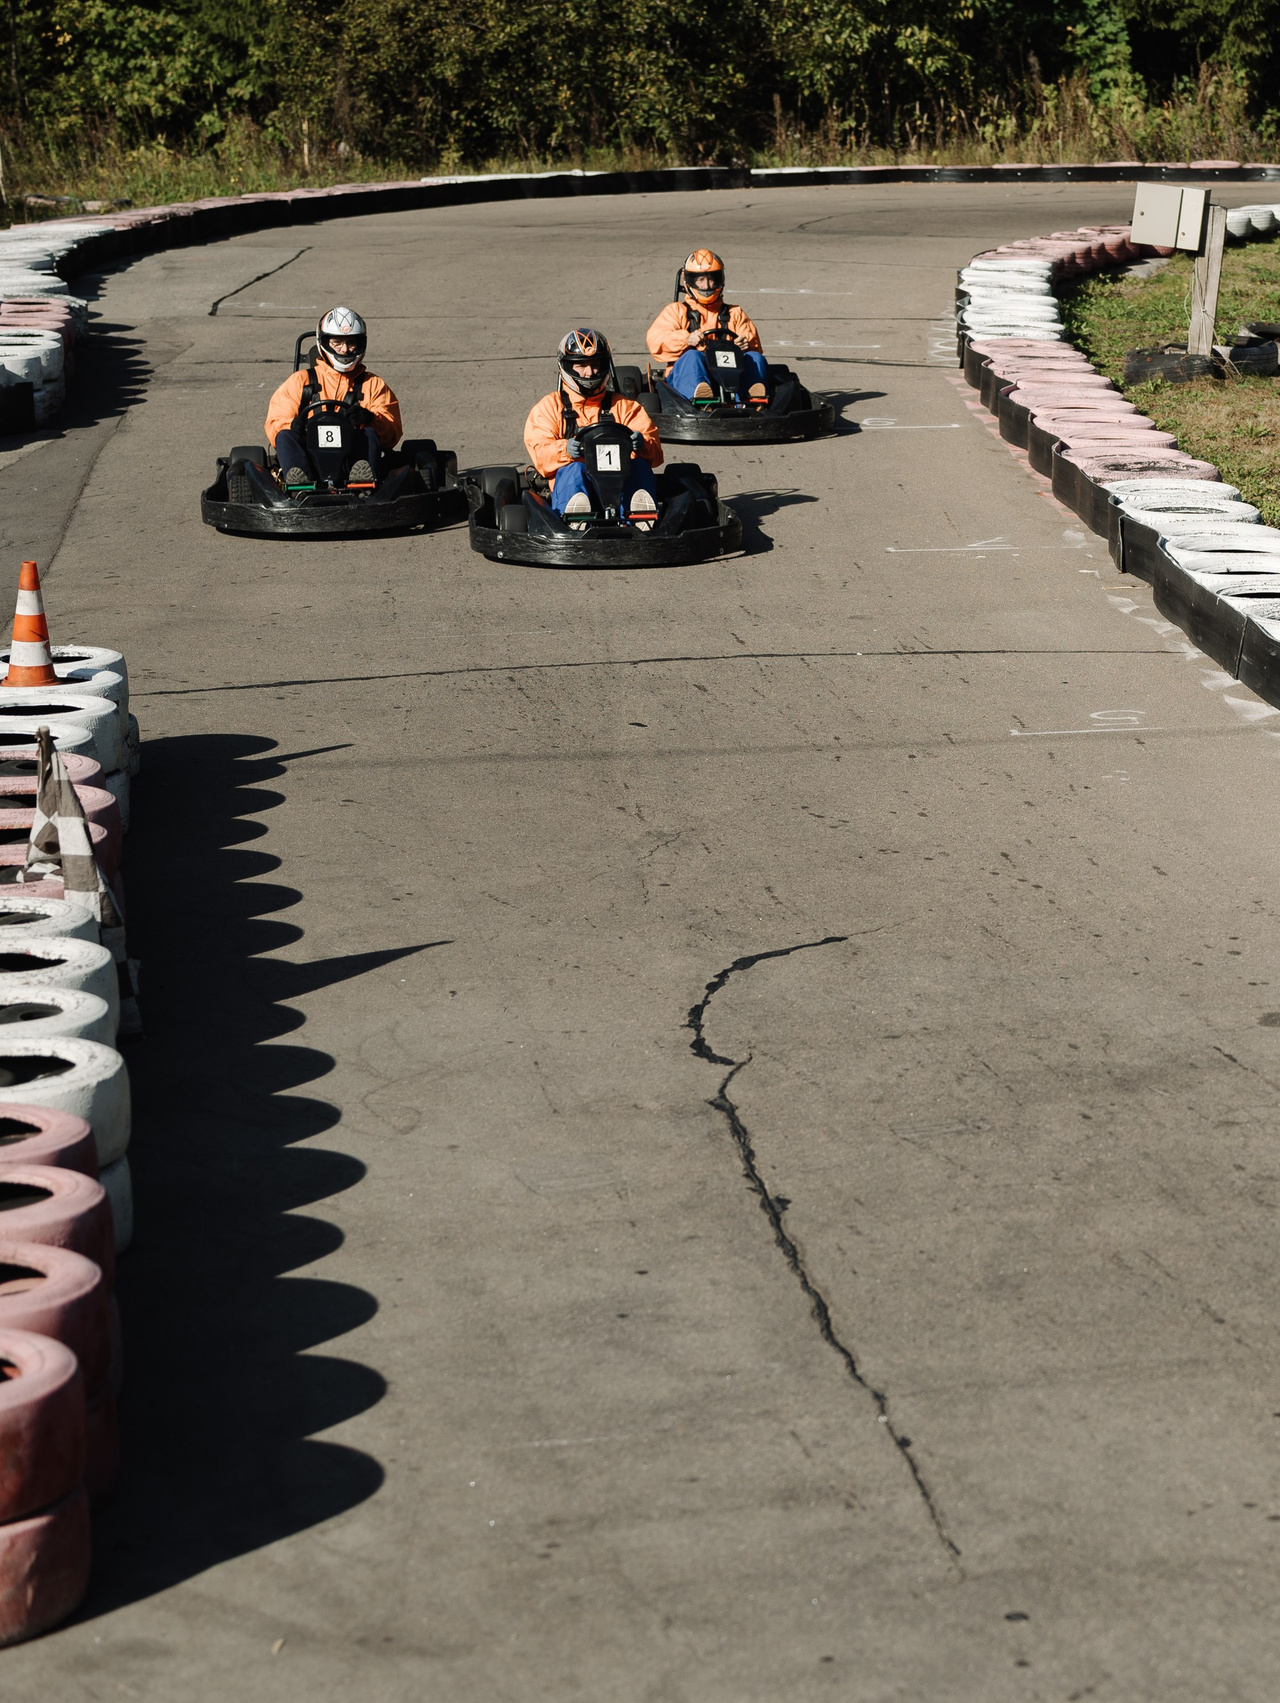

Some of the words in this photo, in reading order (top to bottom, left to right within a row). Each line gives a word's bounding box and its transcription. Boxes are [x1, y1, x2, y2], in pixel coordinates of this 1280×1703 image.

[722, 355, 730, 364] 2
[325, 430, 334, 443] 8
[605, 450, 612, 466] 1
